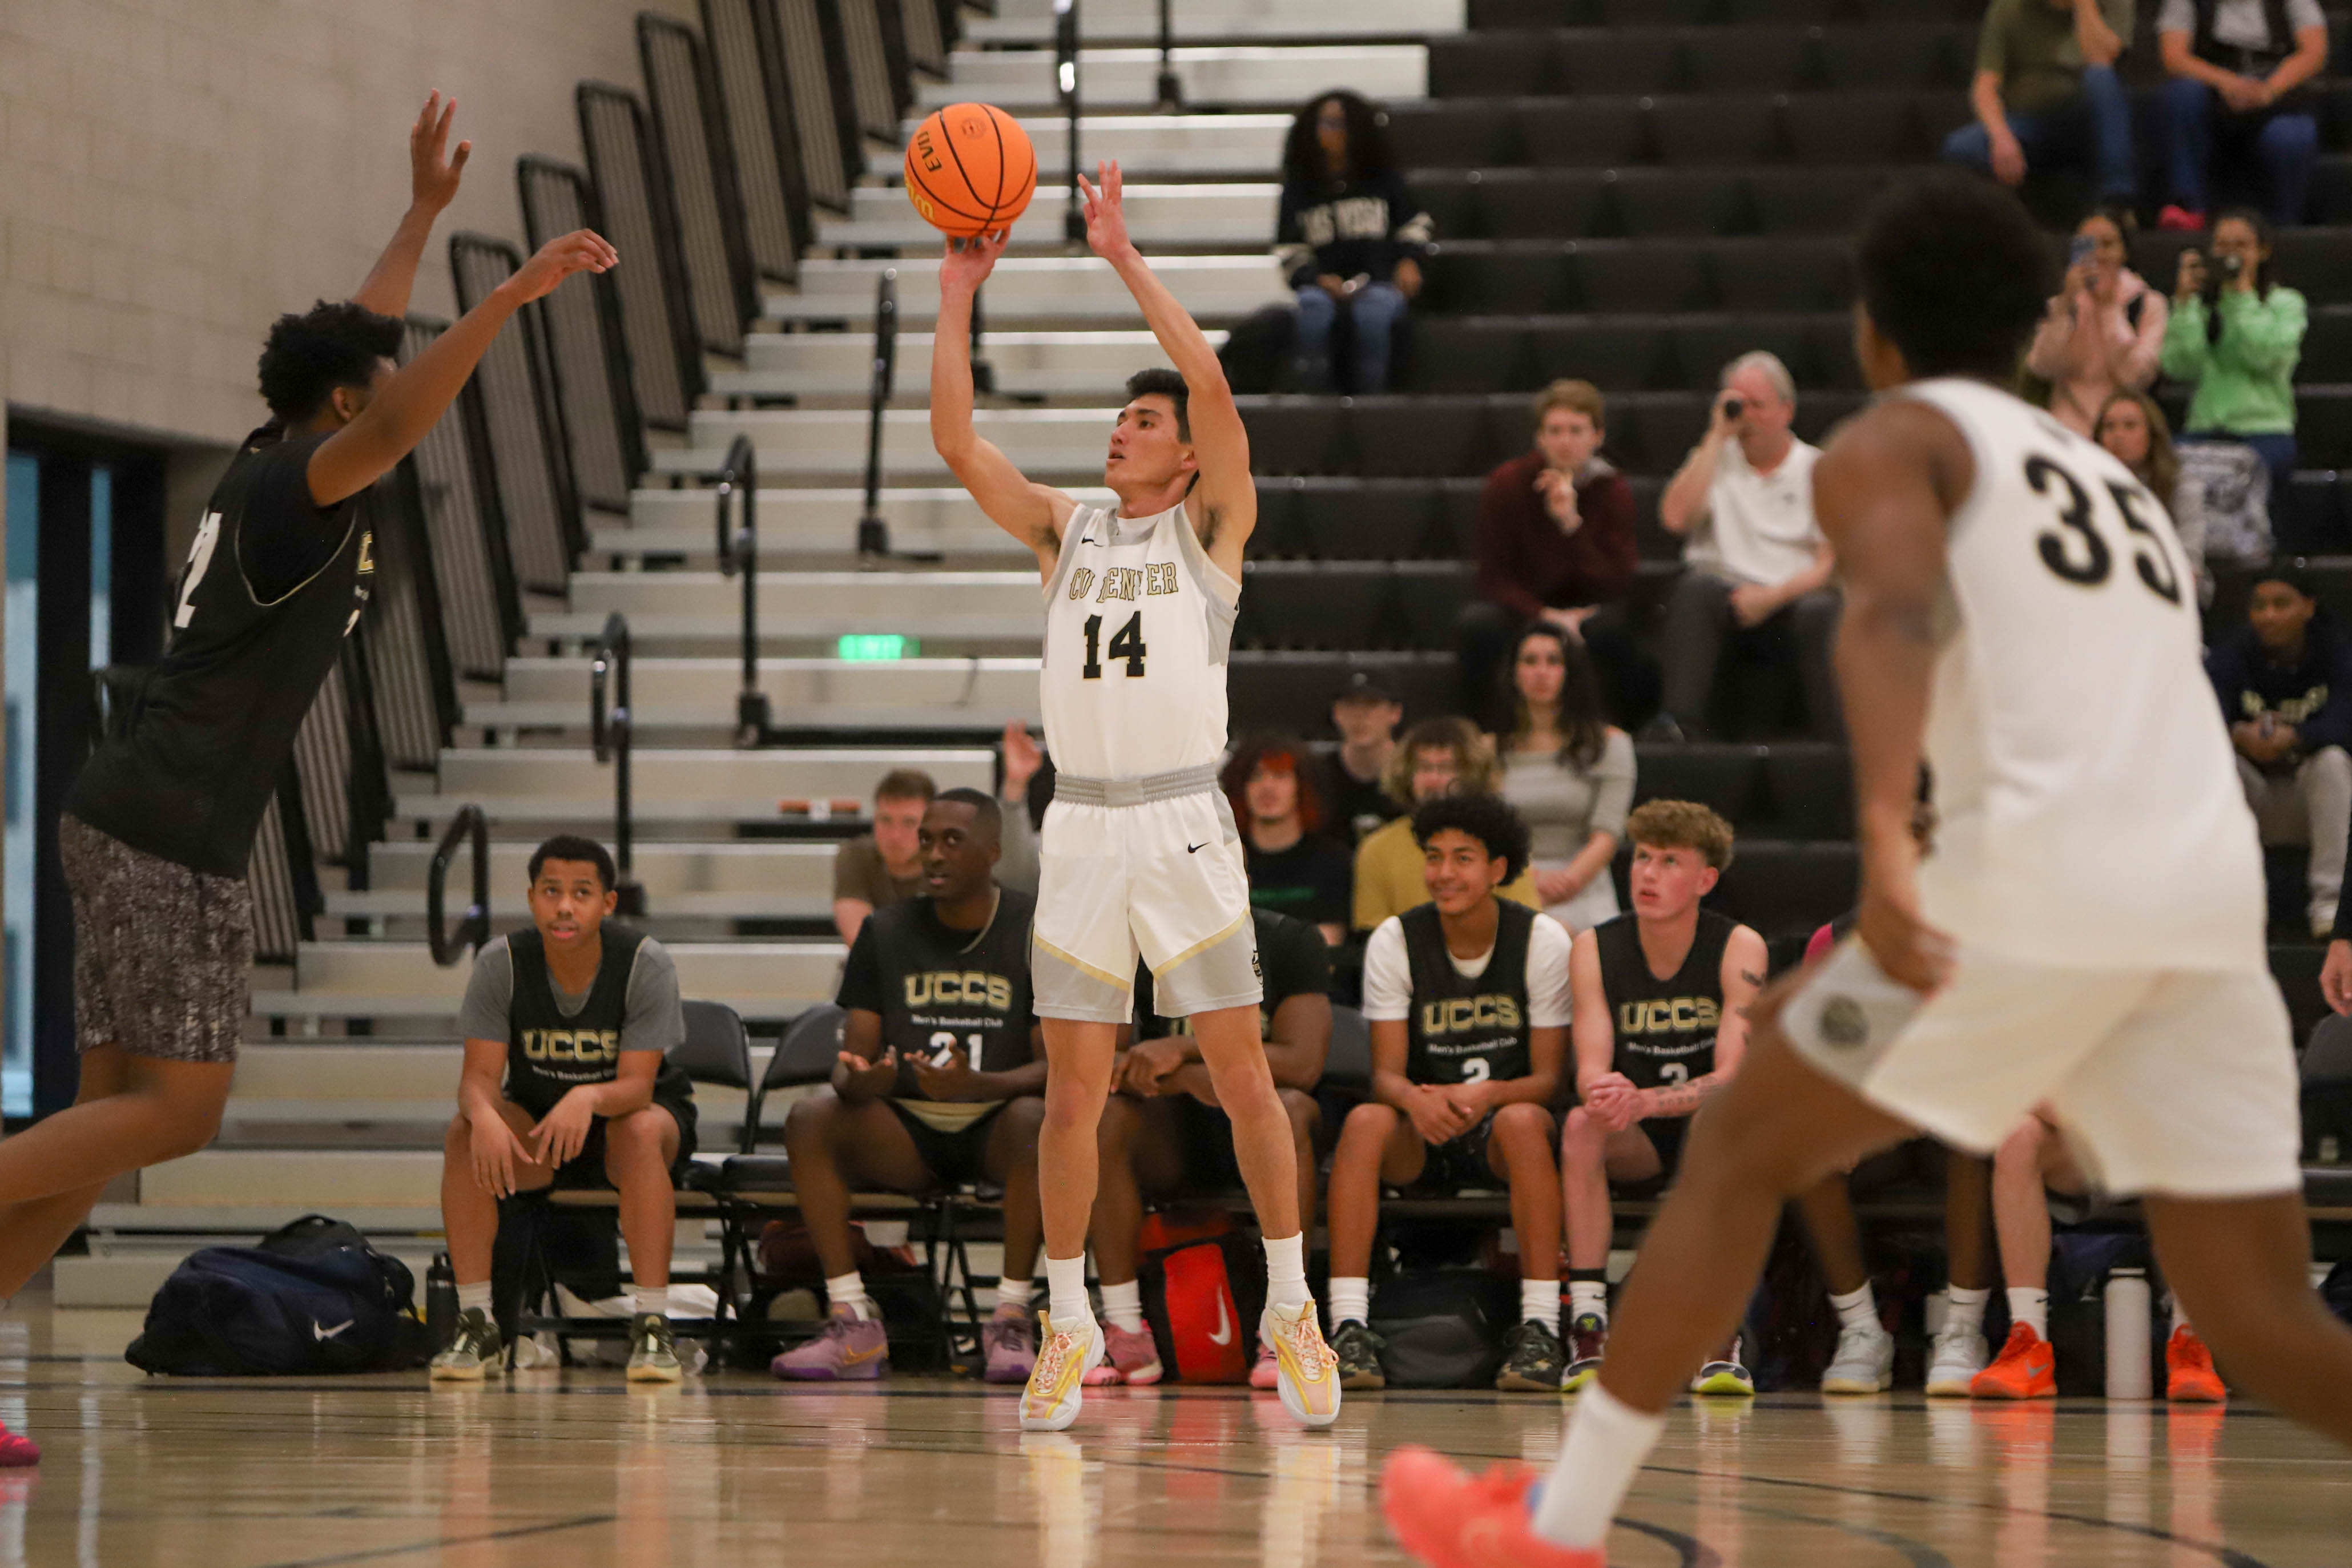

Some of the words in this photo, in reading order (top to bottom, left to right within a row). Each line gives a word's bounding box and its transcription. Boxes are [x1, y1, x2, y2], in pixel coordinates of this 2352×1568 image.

[2024, 454, 2182, 606] 35
[1083, 610, 1147, 679] 14
[904, 971, 1013, 1013] UCCS
[1423, 994, 1522, 1035] UCCS
[1620, 997, 1721, 1033] UCCS
[521, 1029, 618, 1062] UCCS
[929, 1031, 984, 1072] 21
